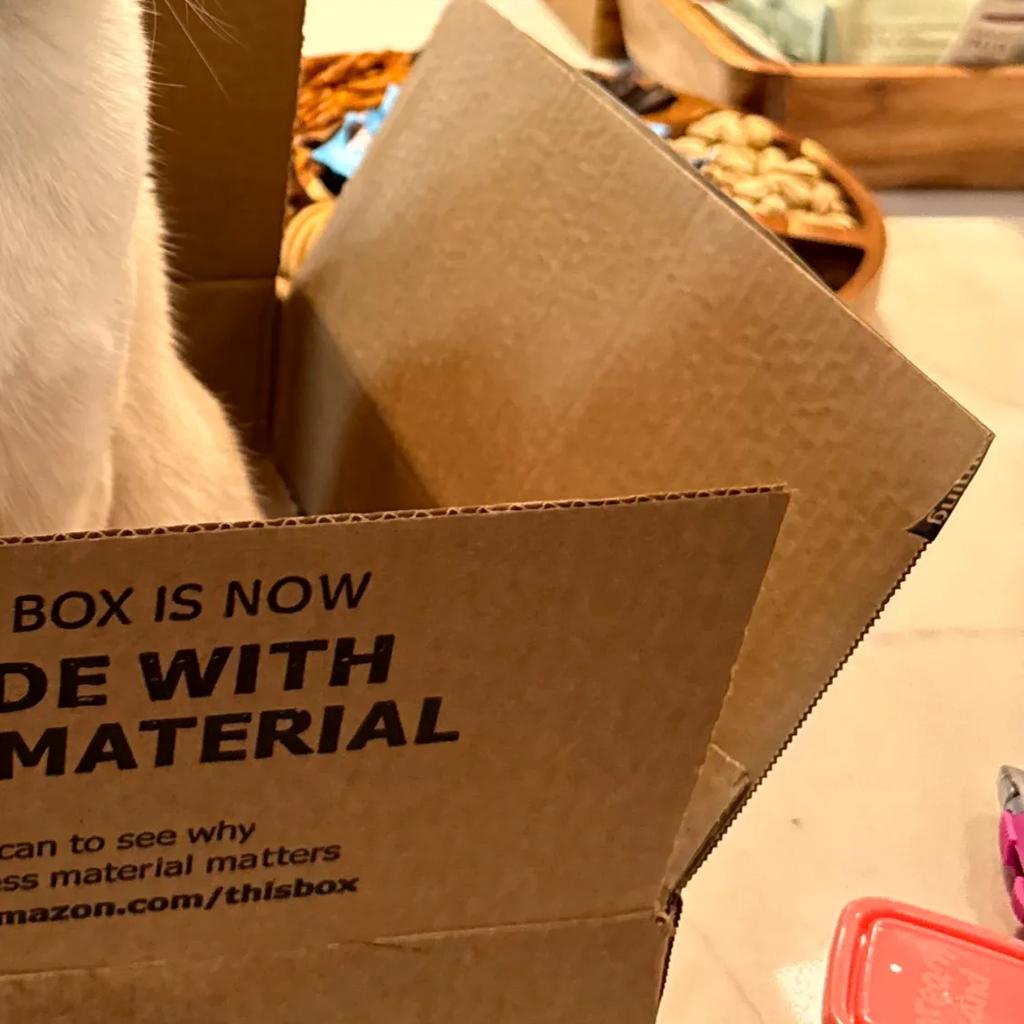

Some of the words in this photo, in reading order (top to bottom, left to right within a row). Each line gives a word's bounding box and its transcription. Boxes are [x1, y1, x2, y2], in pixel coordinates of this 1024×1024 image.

[12, 586, 134, 634] BOX
[154, 583, 203, 623] IS
[224, 571, 373, 619] NOW
[138, 633, 396, 703] WITH
[69, 833, 106, 856] to
[116, 829, 178, 851] see
[187, 819, 256, 846] why
[49, 854, 194, 889] material
[205, 844, 342, 875] matters
